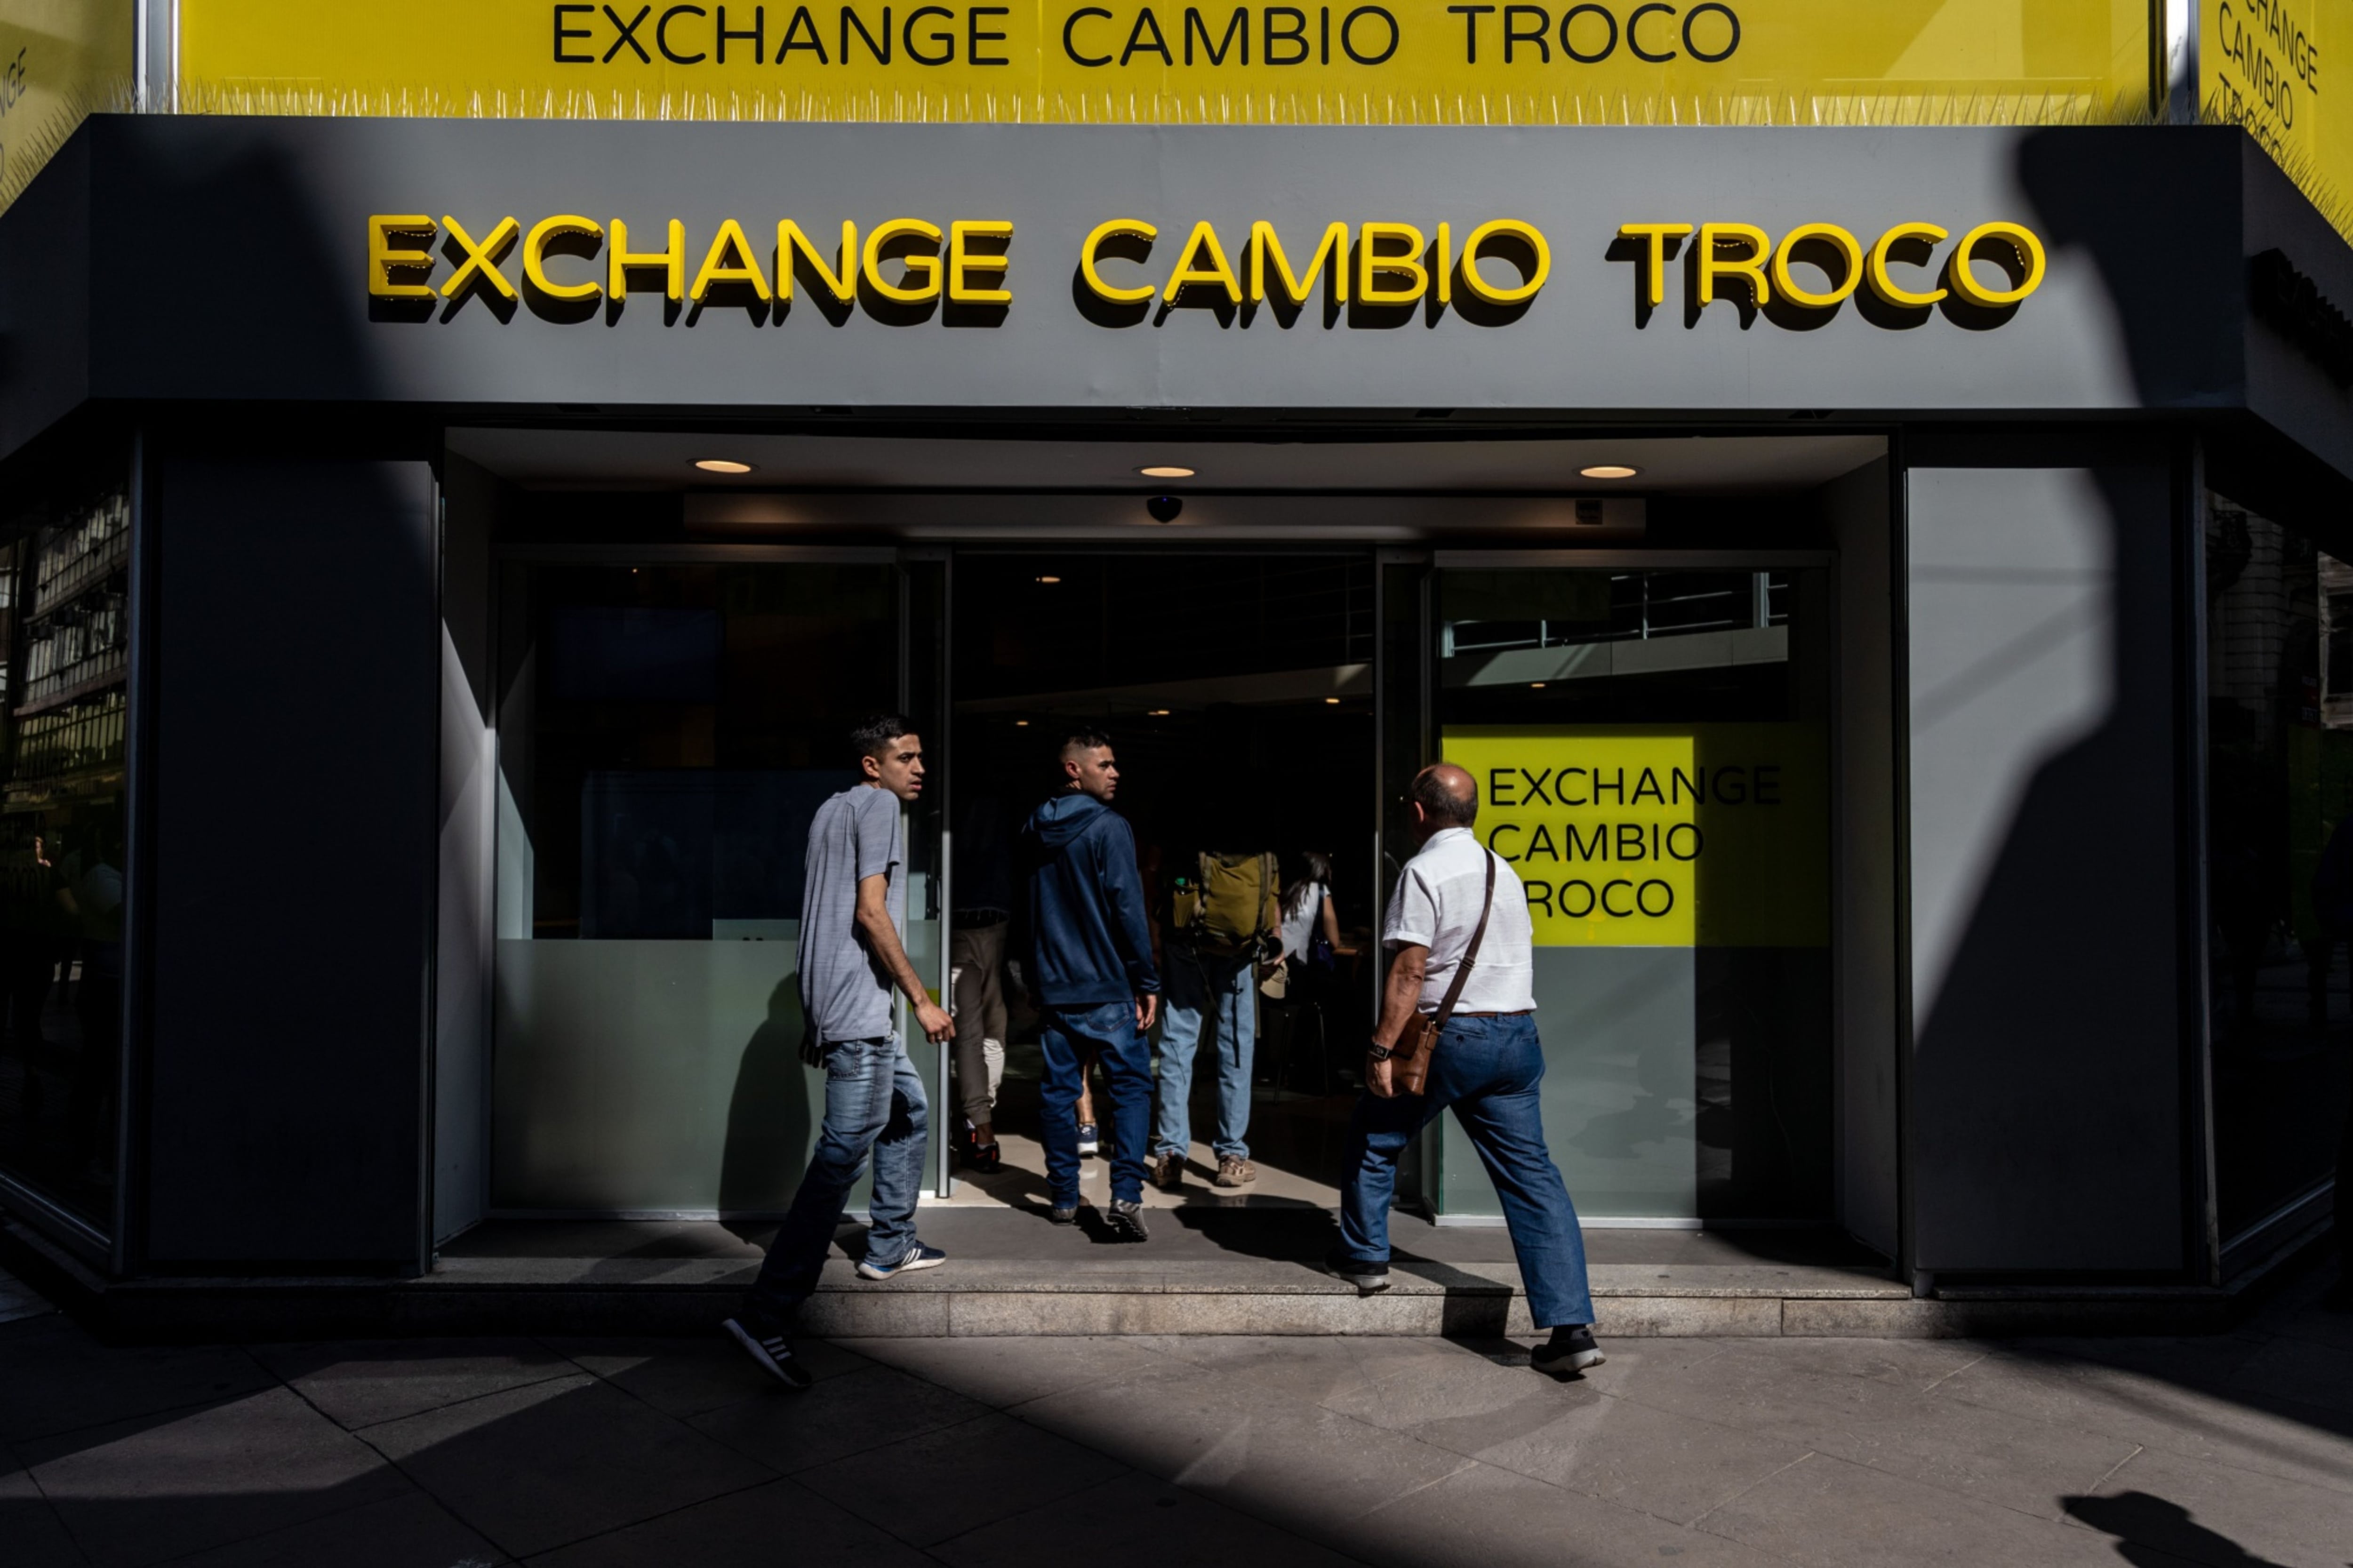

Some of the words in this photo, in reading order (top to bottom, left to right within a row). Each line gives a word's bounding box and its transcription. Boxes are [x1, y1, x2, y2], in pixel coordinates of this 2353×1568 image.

[554, 4, 1010, 66] EXCHANGE
[1063, 6, 1400, 67] CAMBIO
[1447, 3, 1741, 64] TROCO
[2219, 1, 2293, 130] CAMBIO
[2246, 0, 2318, 96] HANGE
[369, 215, 1014, 304] EXCHANGE
[1081, 218, 1551, 306] CAMBIO
[1617, 221, 2046, 308] TROCO
[1489, 767, 1781, 806] EXCHANGE
[1489, 823, 1704, 862] CAMBIO
[1523, 879, 1674, 918] ROCO
